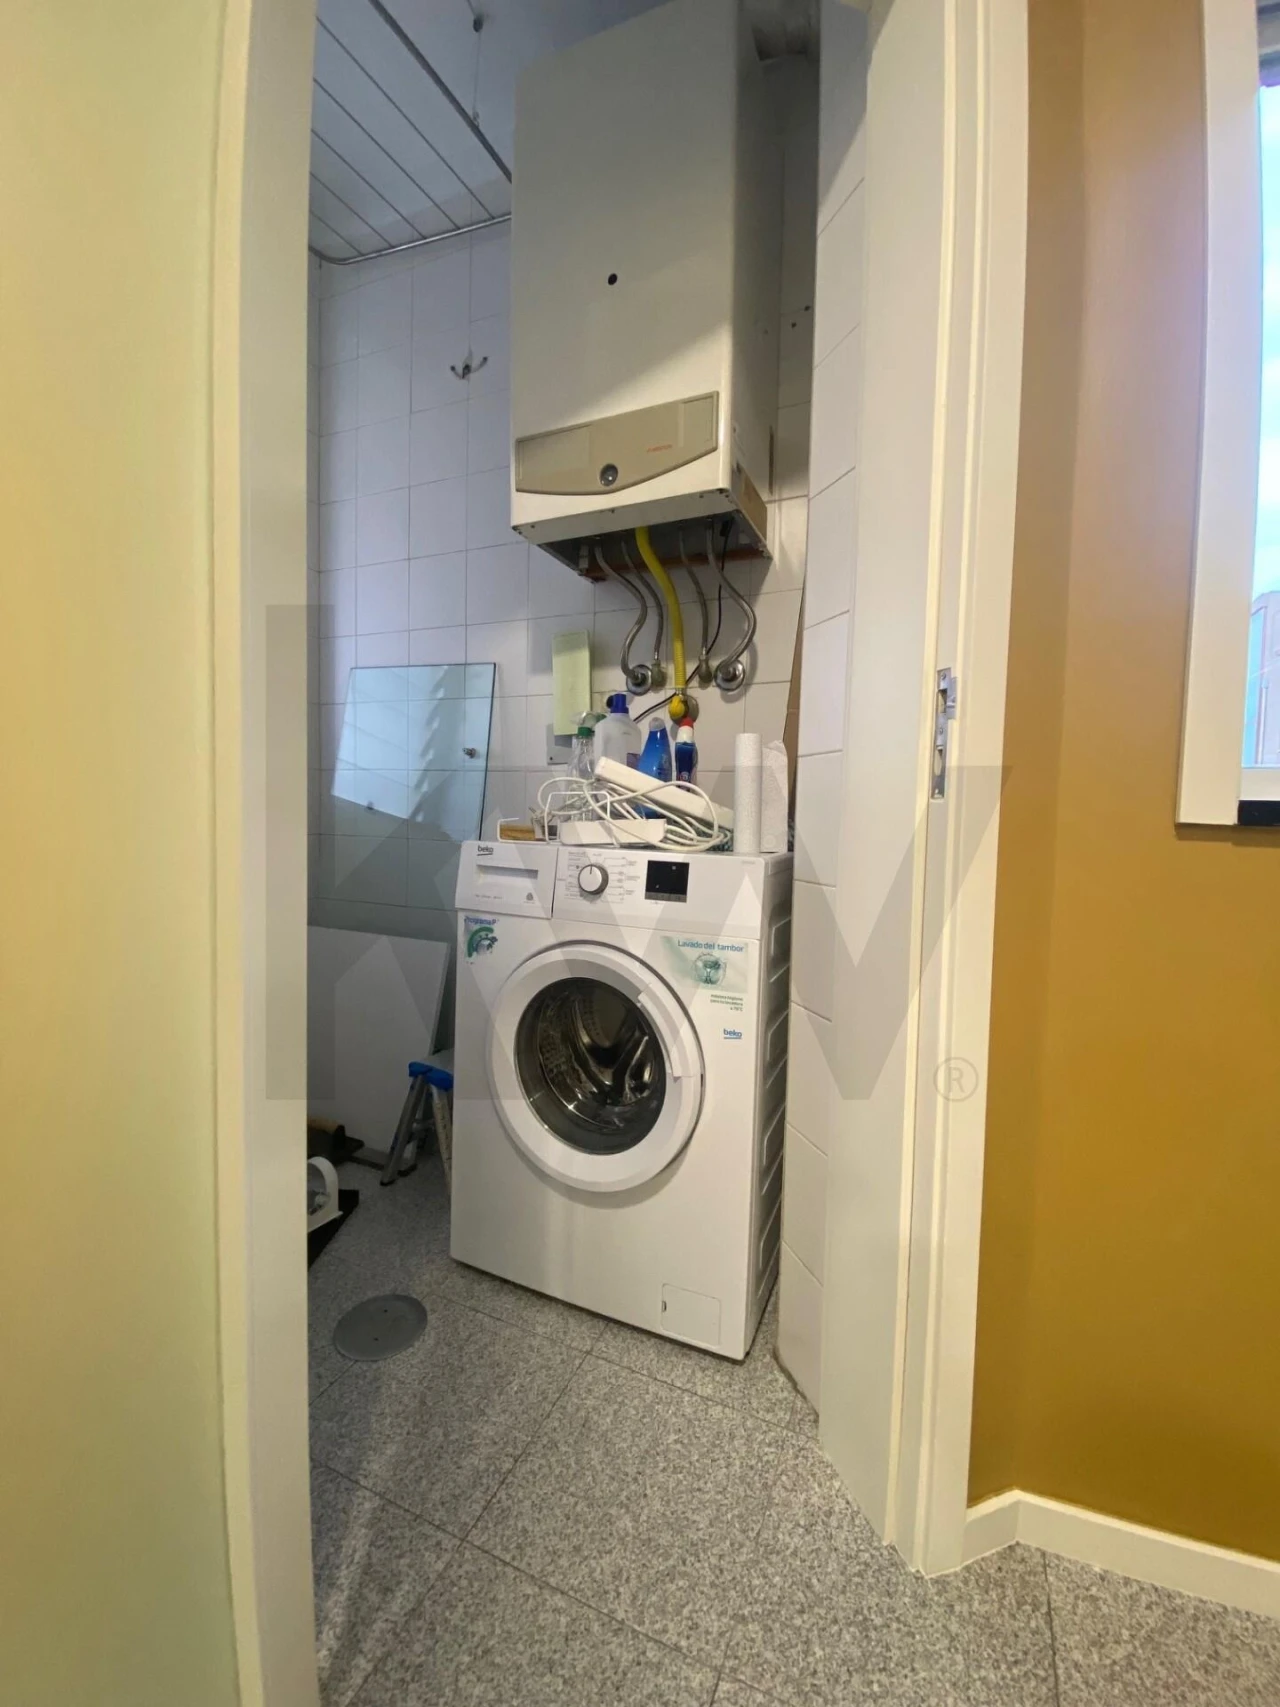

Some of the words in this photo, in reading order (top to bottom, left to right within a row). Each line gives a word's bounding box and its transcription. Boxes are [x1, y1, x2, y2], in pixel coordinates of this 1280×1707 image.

[477, 845, 494, 856] beko
[678, 939, 703, 949] Lavado
[703, 940, 716, 950] del
[717, 943, 744, 952] tambor
[723, 1028, 743, 1039] beko
